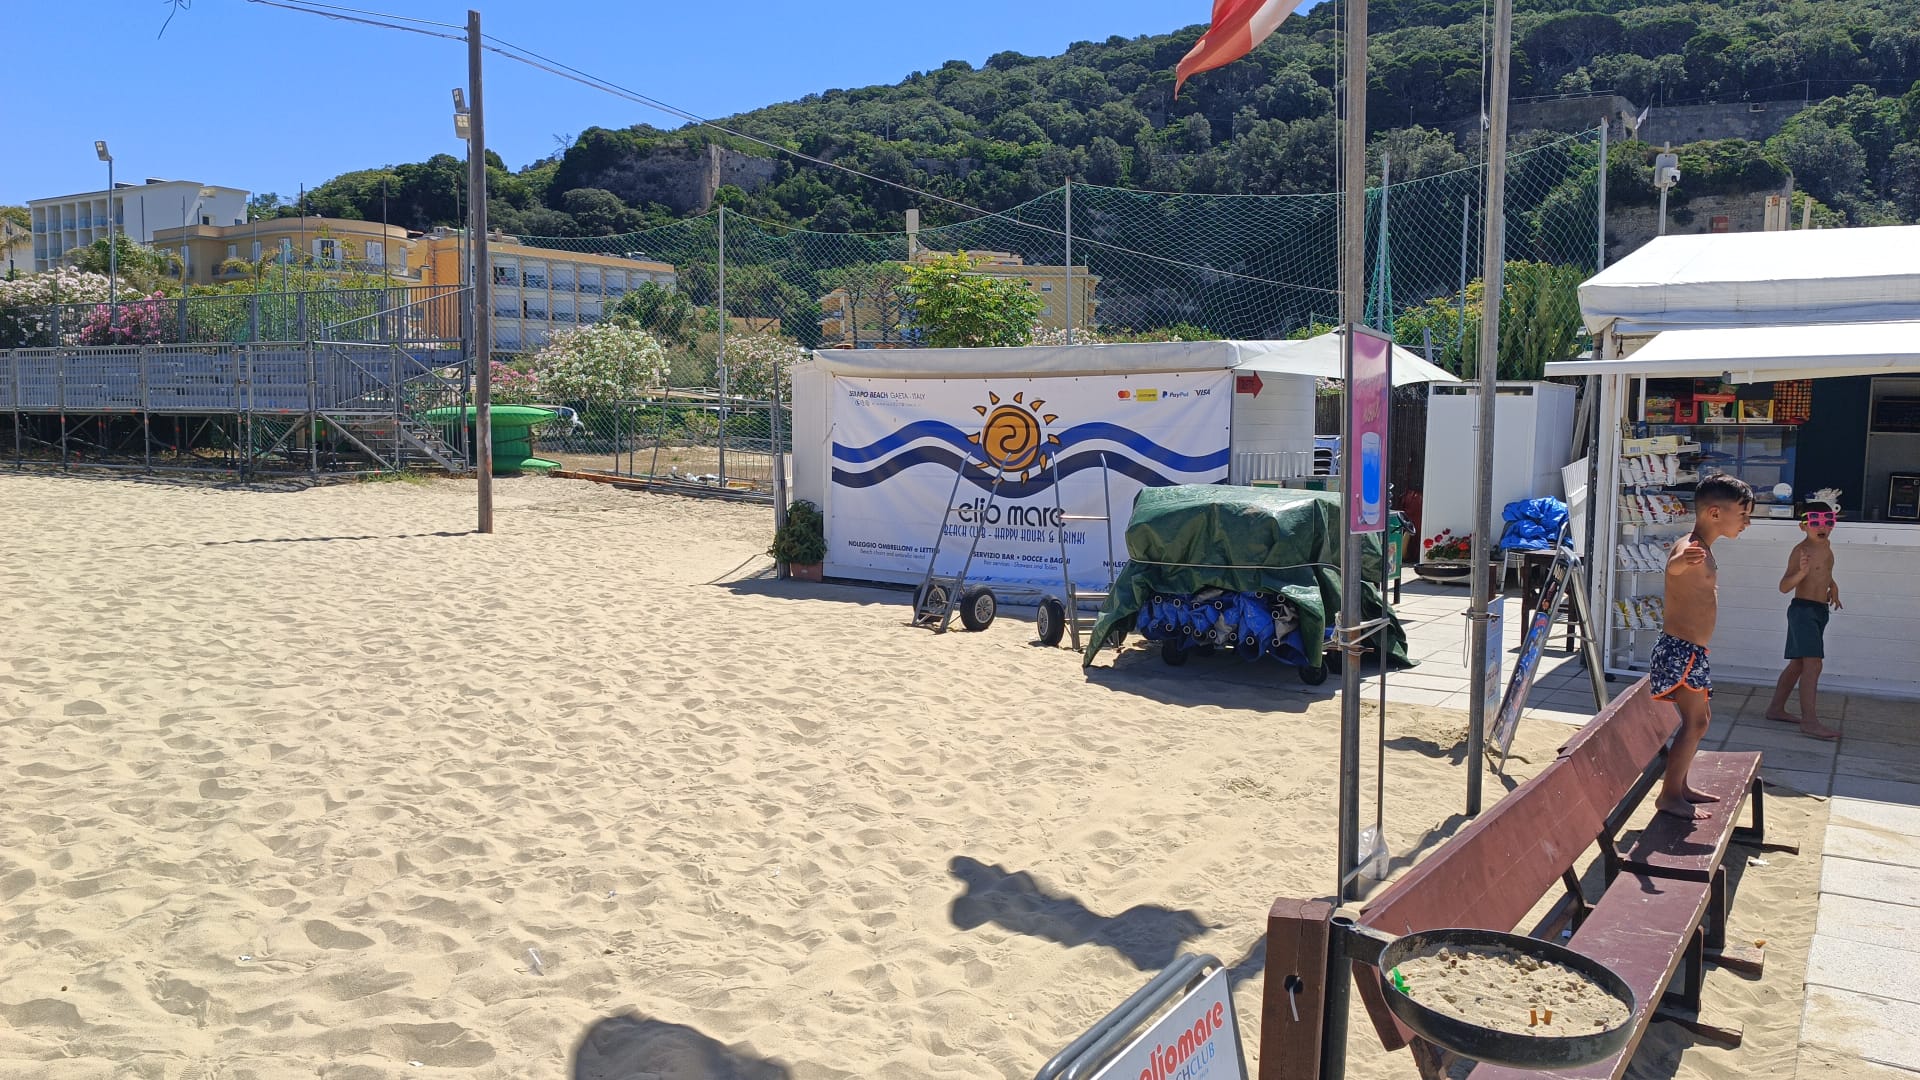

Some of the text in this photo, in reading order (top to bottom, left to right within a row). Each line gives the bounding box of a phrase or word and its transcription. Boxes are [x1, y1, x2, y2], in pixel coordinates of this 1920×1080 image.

[869, 391, 888, 399] BEACH
[1194, 388, 1211, 396] VISA
[958, 498, 1066, 528] elio mare
[943, 524, 967, 537] BEACH
[994, 527, 1019, 540] HAPPY
[1021, 529, 1046, 543] HOURS
[1048, 531, 1055, 543] &
[972, 551, 1001, 560] SERVIZIO
[1002, 553, 1015, 561] BAR
[1022, 555, 1043, 563] DOCCE
